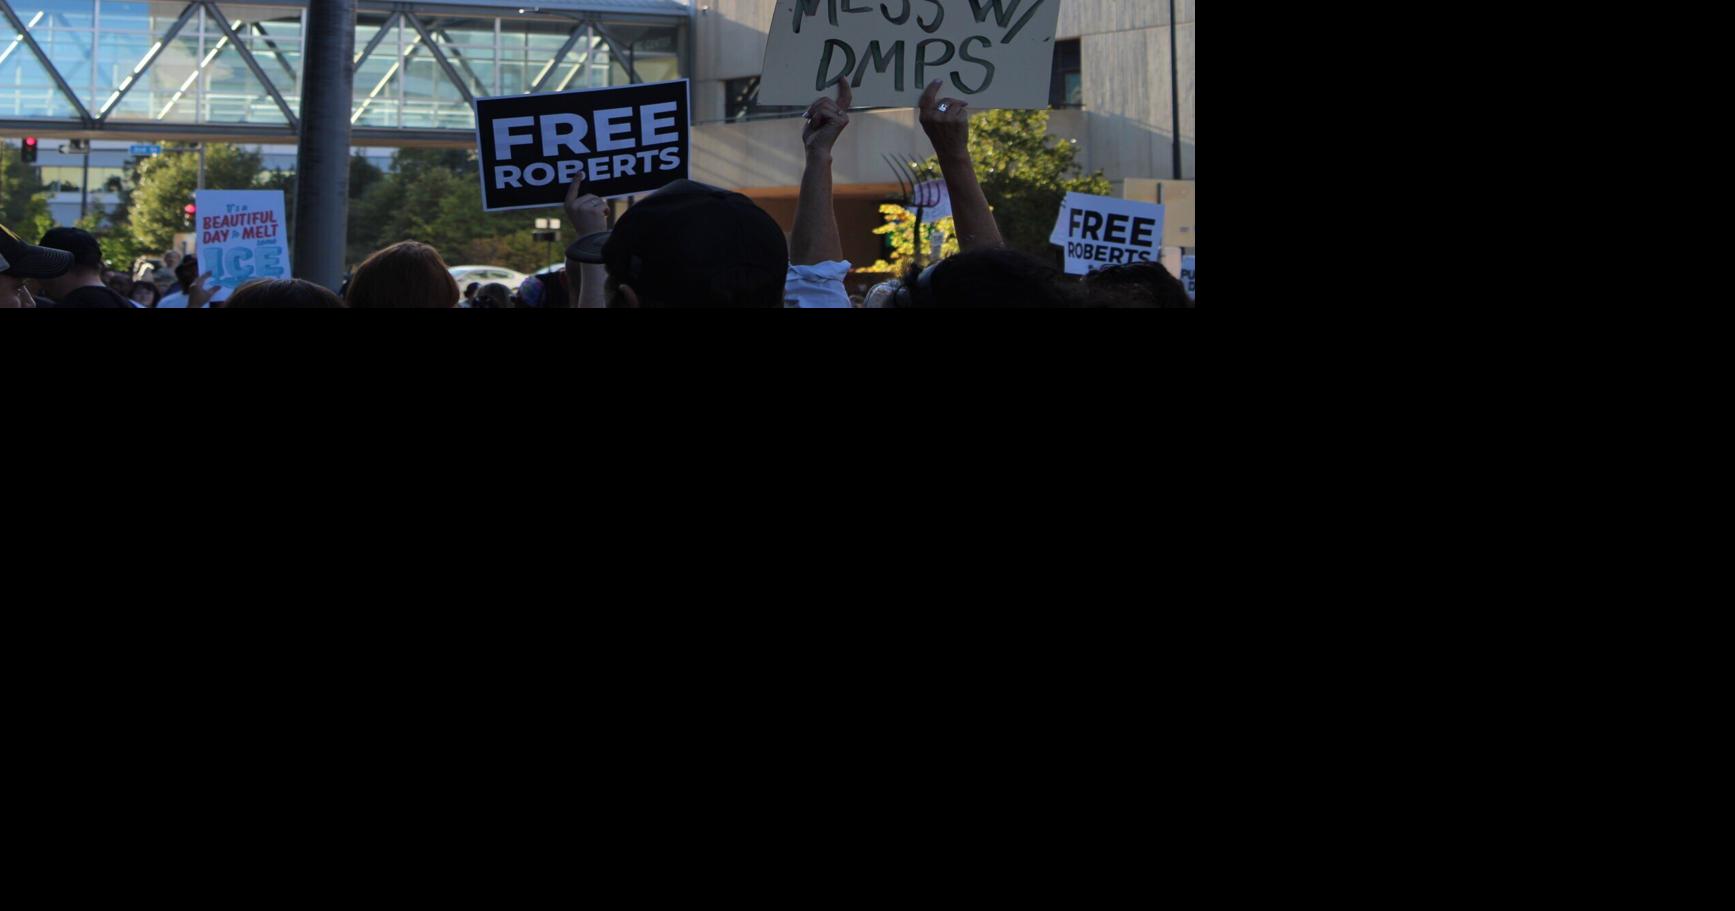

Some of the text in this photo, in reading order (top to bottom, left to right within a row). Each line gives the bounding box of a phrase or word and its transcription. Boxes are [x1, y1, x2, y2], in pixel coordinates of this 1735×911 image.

[815, 35, 996, 95] DMPS
[492, 101, 680, 161] FREE
[493, 146, 681, 190] ROBERTS
[203, 211, 277, 229] BEAUTIFUL
[203, 230, 229, 244] DAY
[242, 224, 278, 239] MELT
[1069, 208, 1155, 247] FREE
[203, 246, 284, 281] ICE
[1067, 242, 1152, 265] ROBERTS
